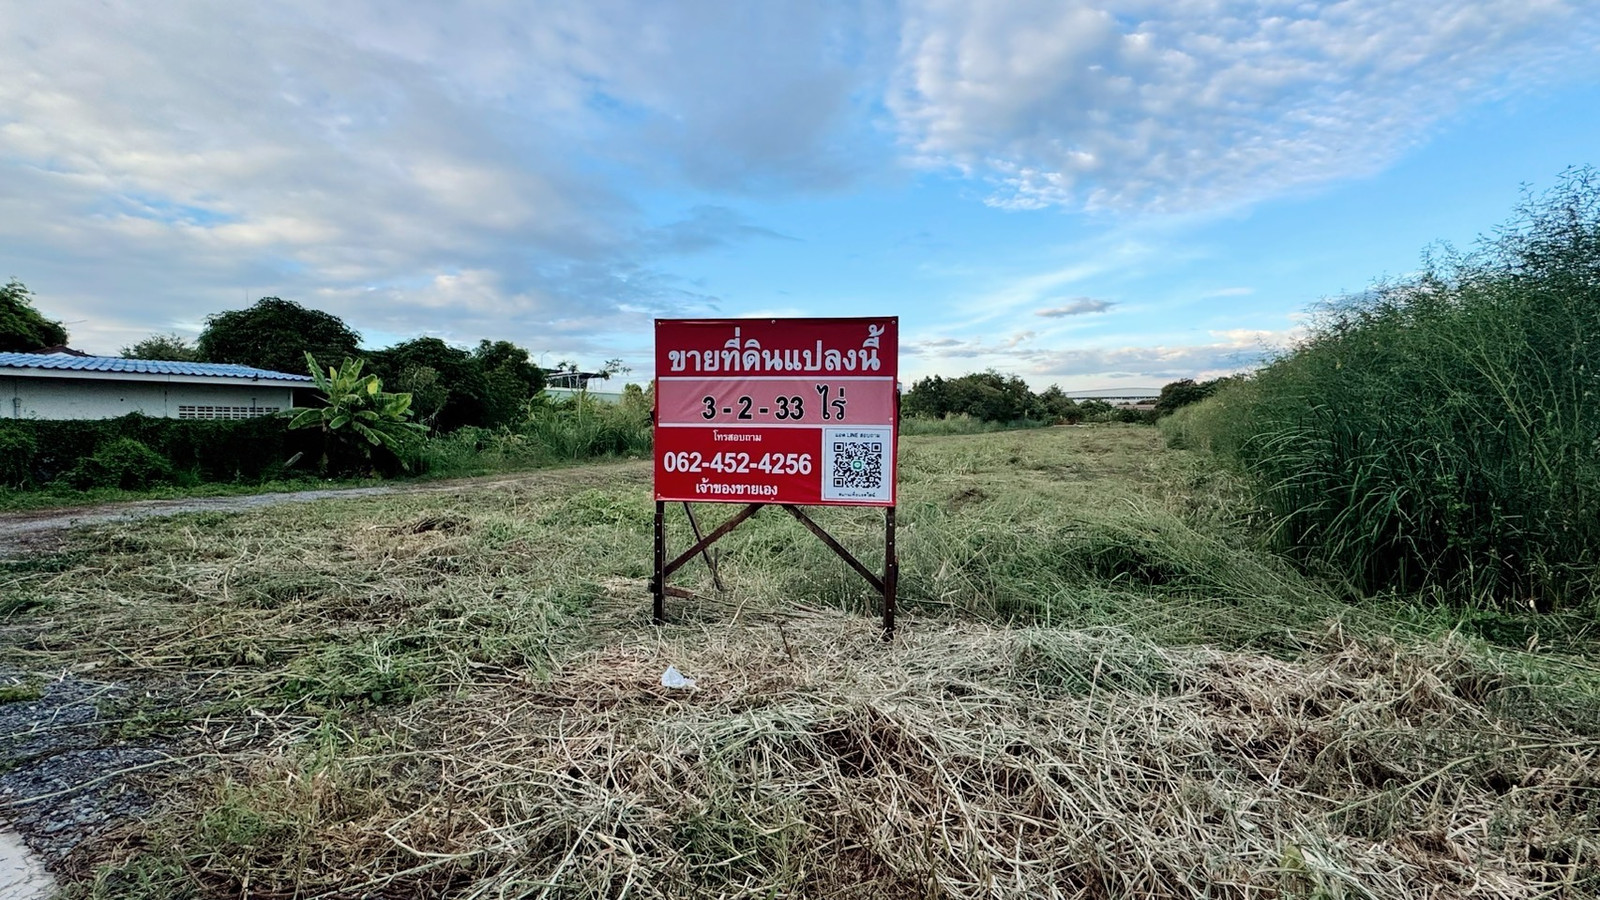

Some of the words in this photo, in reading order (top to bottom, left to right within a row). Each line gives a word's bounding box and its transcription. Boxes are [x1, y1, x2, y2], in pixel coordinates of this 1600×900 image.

[668, 324, 885, 372] ขายที่ดินแปลงนี้
[775, 396, 804, 420] 33
[816, 384, 847, 421] ไร่
[713, 429, 762, 442] โทรสอบถาม
[663, 452, 812, 475] 062-452-4256
[695, 478, 778, 496] เจ้าของขายเอง
